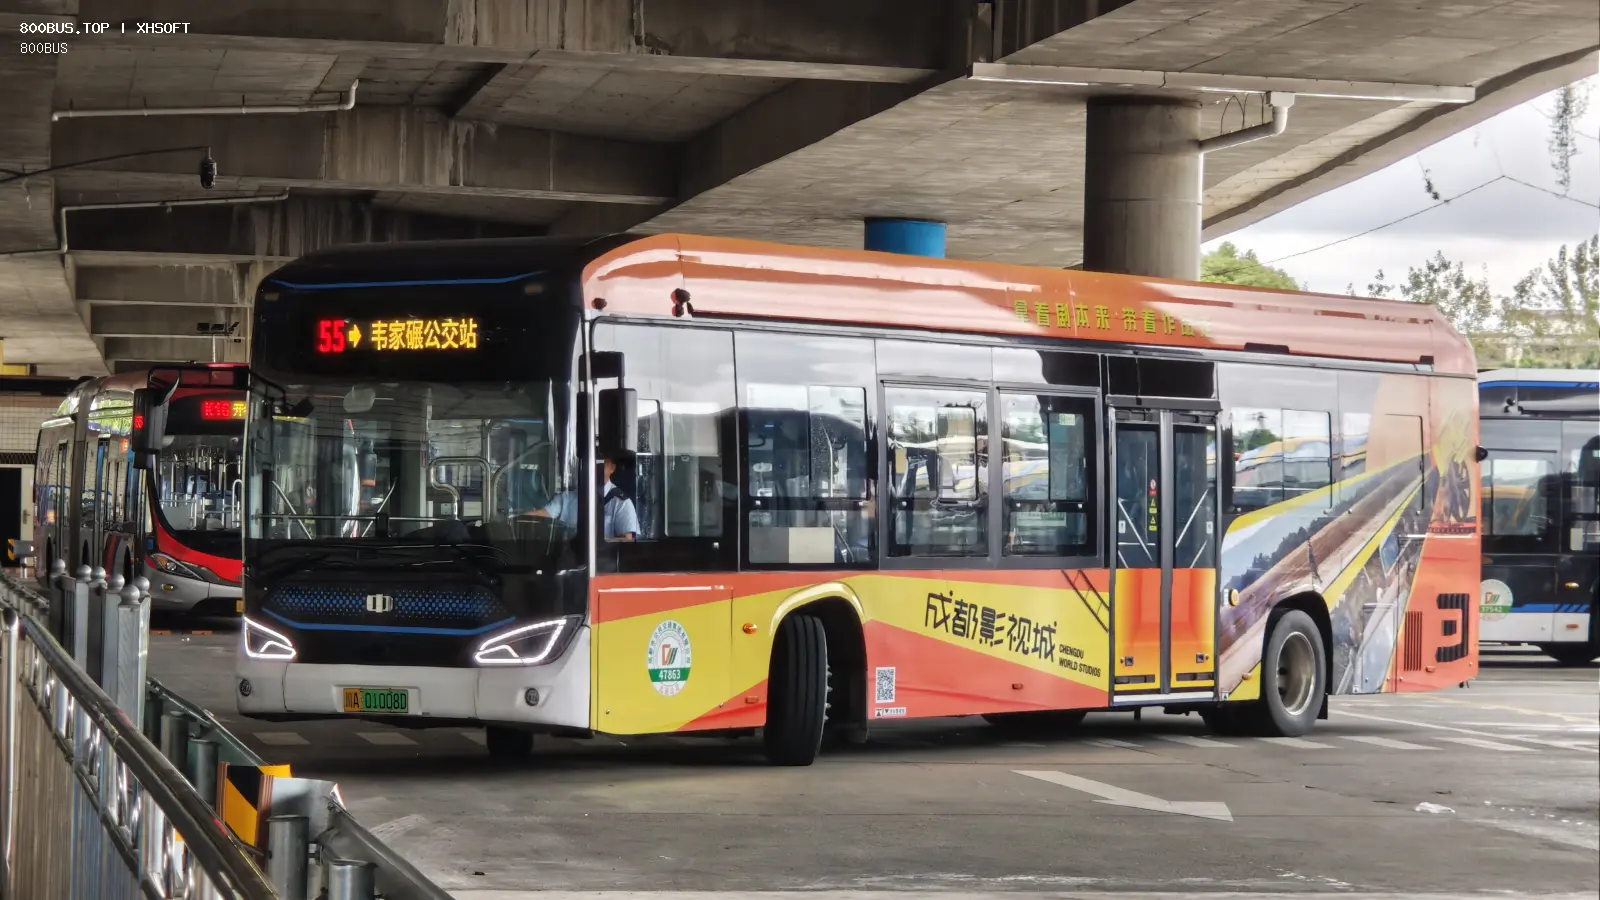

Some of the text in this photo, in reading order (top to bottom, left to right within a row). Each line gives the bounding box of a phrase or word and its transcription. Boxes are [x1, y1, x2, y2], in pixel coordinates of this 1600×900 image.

[319, 318, 478, 352] 55 韦家碾公交站
[925, 590, 1058, 663] 成都影视城
[1059, 643, 1085, 660] CHENGDU
[1059, 657, 1102, 678] WORLD STUDIOS
